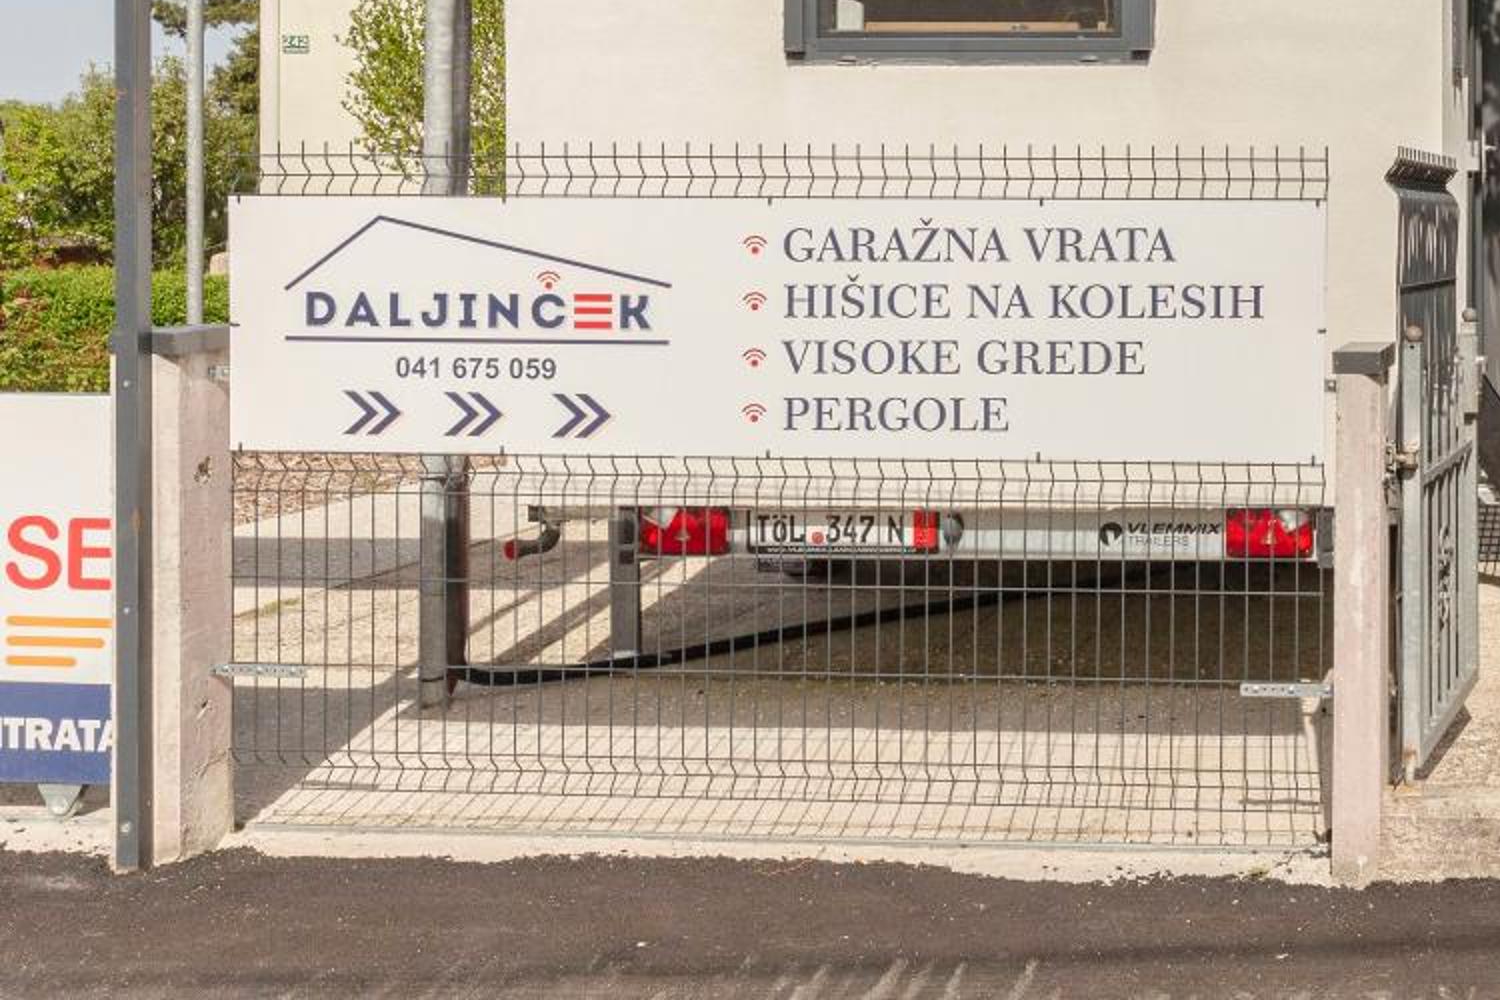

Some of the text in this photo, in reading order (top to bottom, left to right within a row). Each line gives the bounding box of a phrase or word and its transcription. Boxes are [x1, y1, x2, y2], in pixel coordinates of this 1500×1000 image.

[783, 217, 1177, 263] GARAŽNA VRATA
[783, 274, 1265, 320] HIŠICE NA KOLESIH
[395, 356, 557, 381] 041 675 059
[781, 339, 1146, 376] VISOKE GREDE
[783, 396, 1010, 433] PERGOLE
[828, 514, 875, 543] 347
